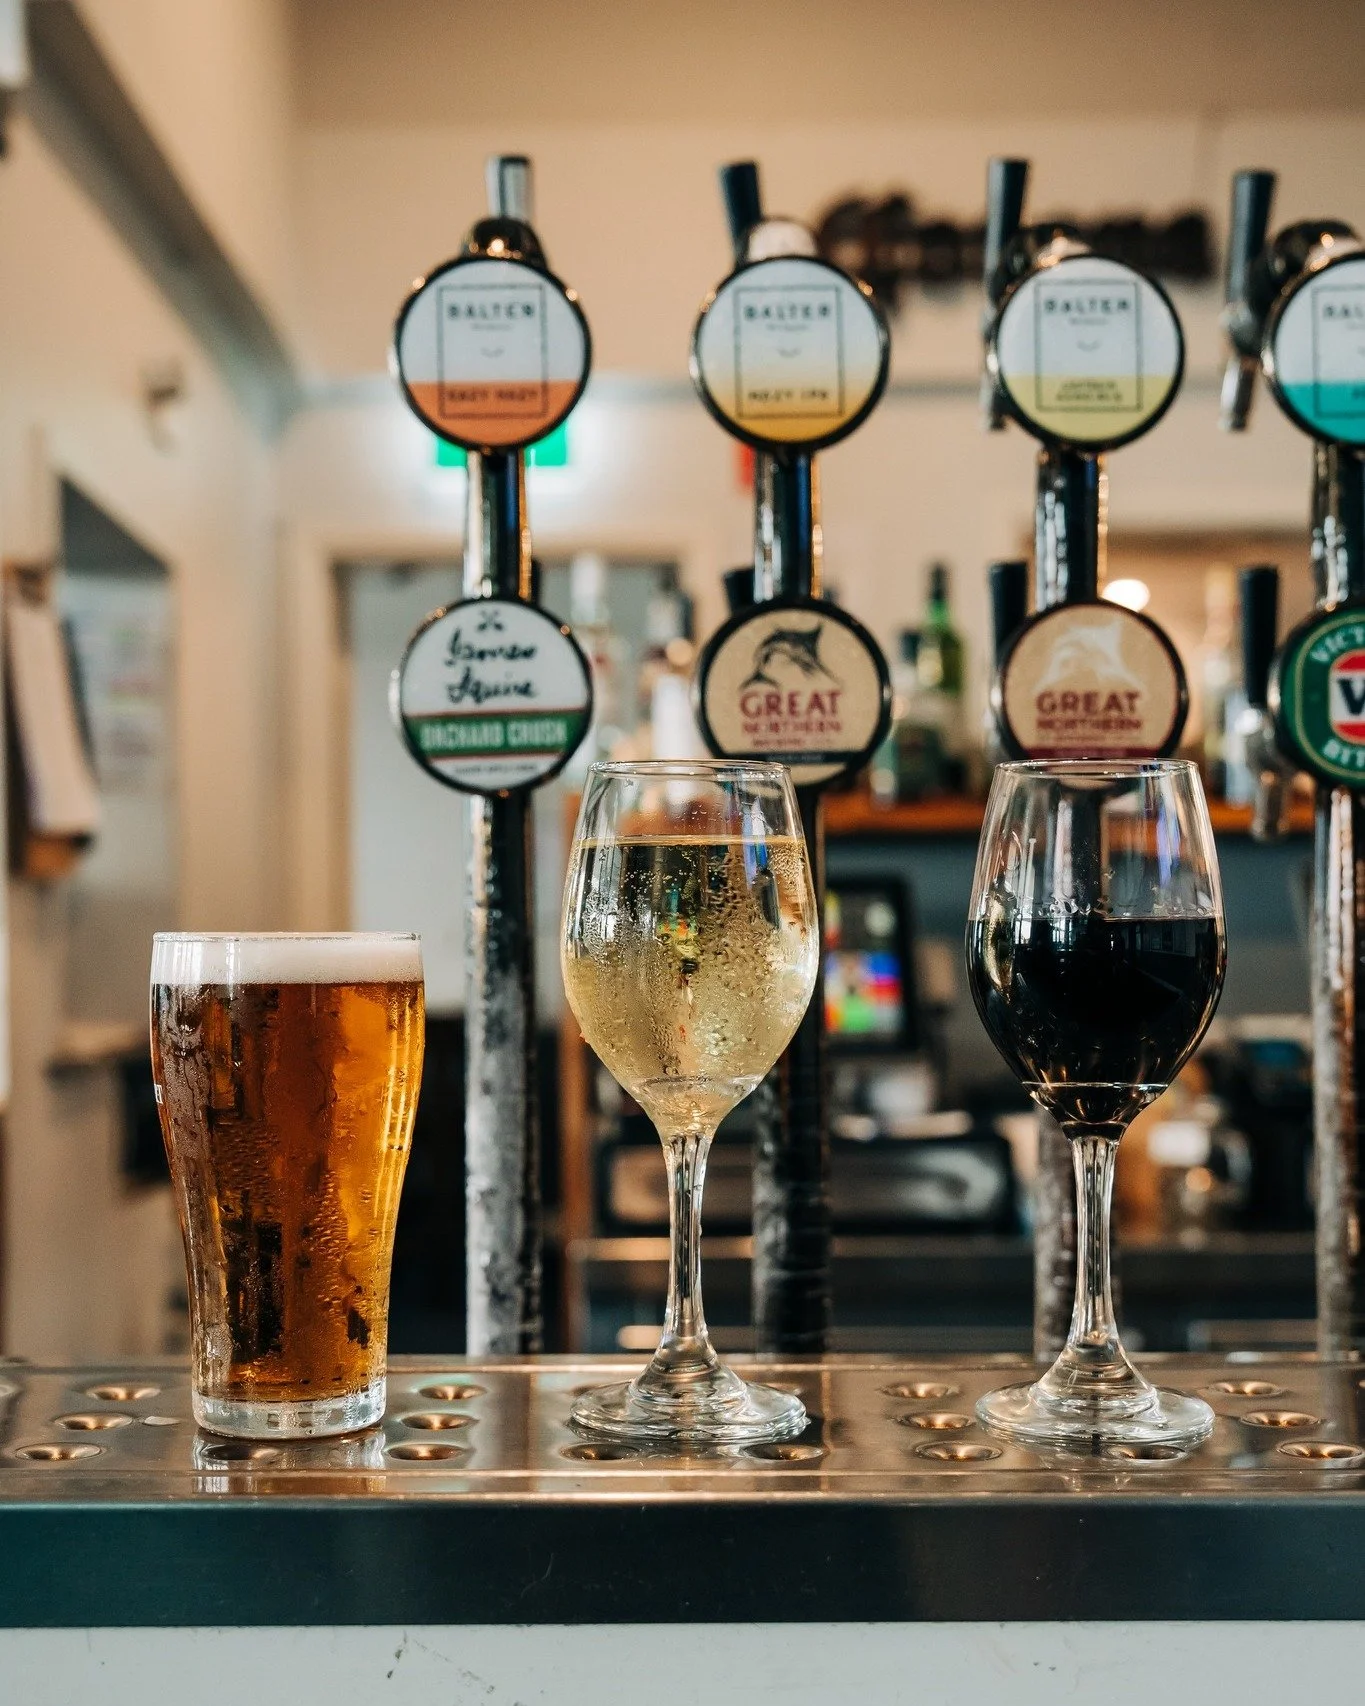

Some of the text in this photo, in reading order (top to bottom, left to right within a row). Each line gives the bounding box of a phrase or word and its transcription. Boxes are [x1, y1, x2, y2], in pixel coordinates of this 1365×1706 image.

[745, 303, 830, 320] BALTER
[1044, 298, 1130, 314] BALTER
[739, 689, 842, 719] GREAT
[1036, 690, 1140, 715] GREAT
[741, 719, 843, 734] NORTHERN
[1035, 717, 1143, 731] NORTHERN
[419, 717, 567, 750] ORCHARD CRUSH
